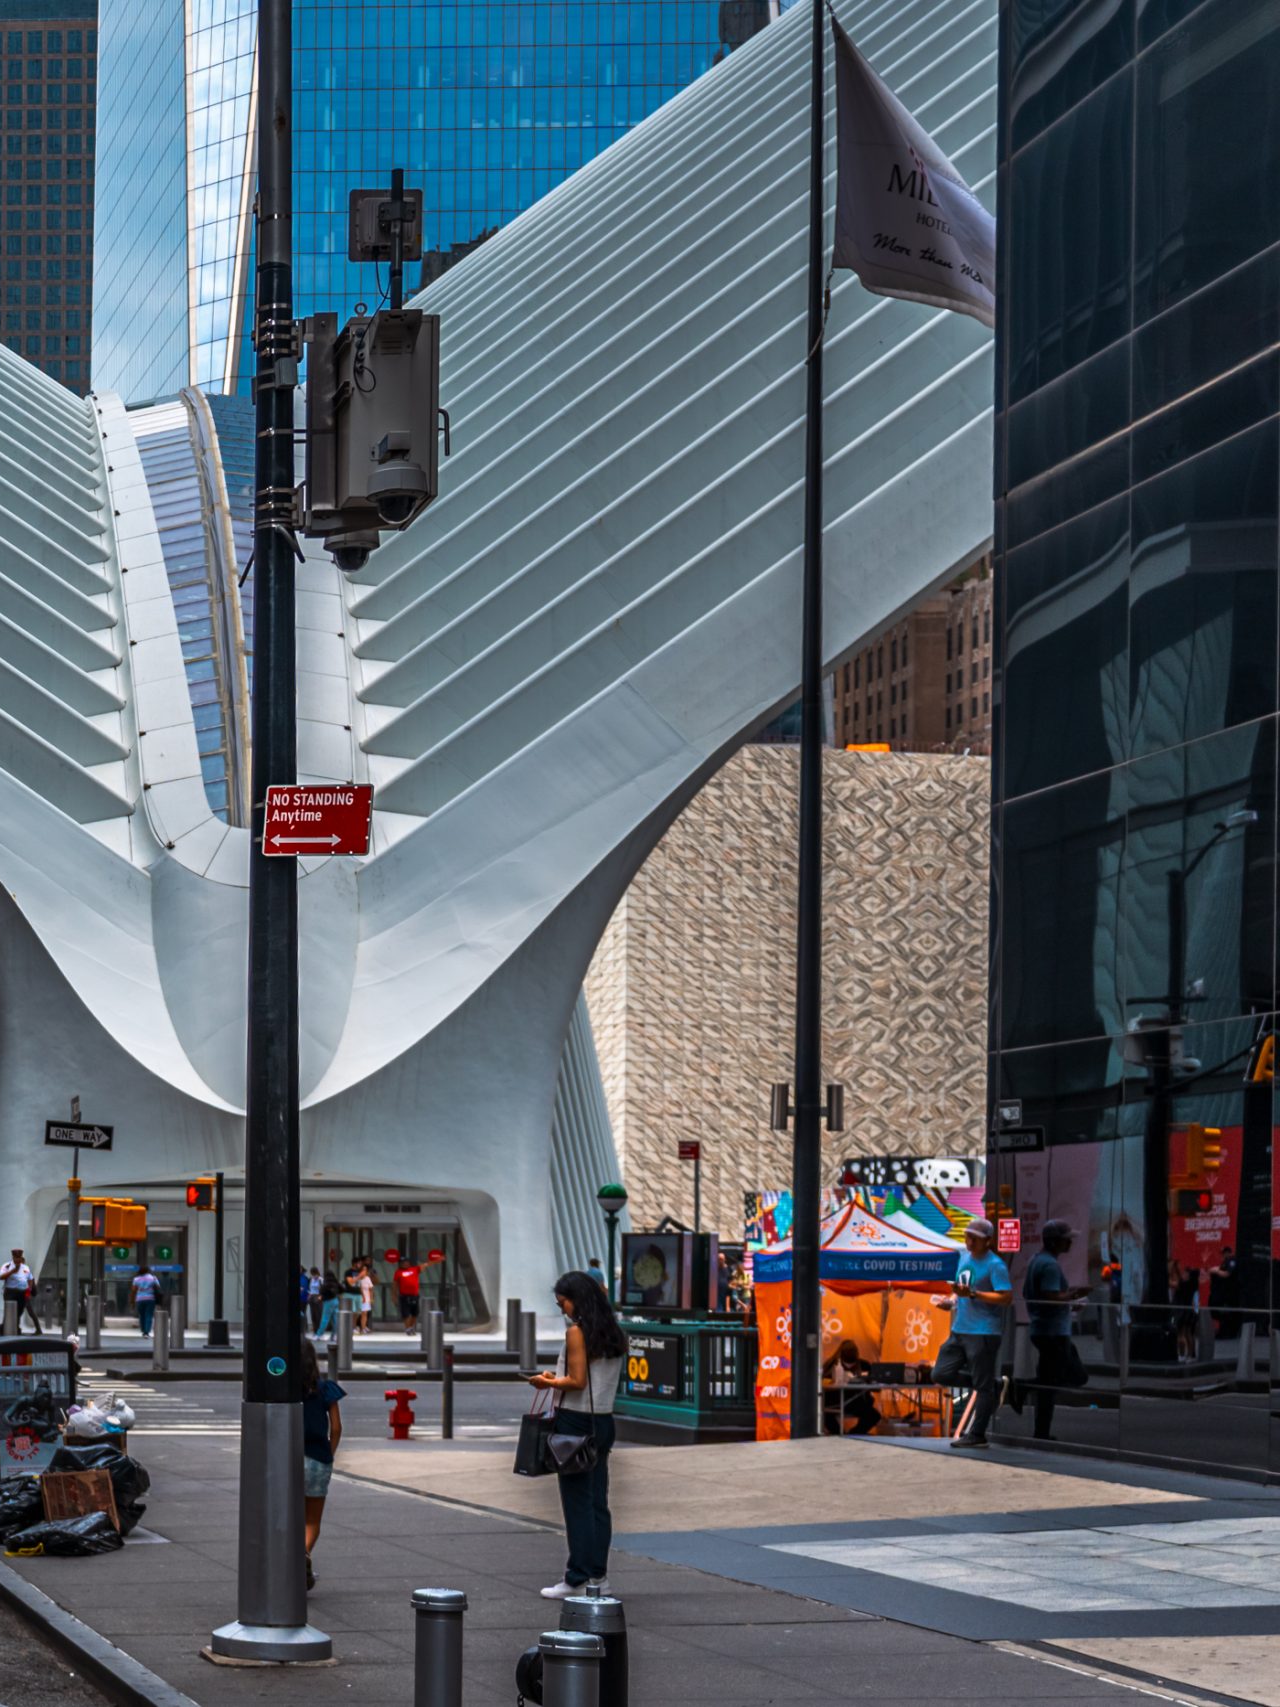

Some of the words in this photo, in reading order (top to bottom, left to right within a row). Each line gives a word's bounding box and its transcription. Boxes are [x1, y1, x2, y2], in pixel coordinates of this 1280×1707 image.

[272, 793, 290, 806] NO
[293, 792, 354, 806] STANDING
[272, 809, 322, 824] Anytime
[55, 1128, 75, 1140] ONE
[82, 1130, 103, 1142] WAY
[863, 1258, 896, 1271] COVID
[899, 1260, 942, 1272] TESTING
